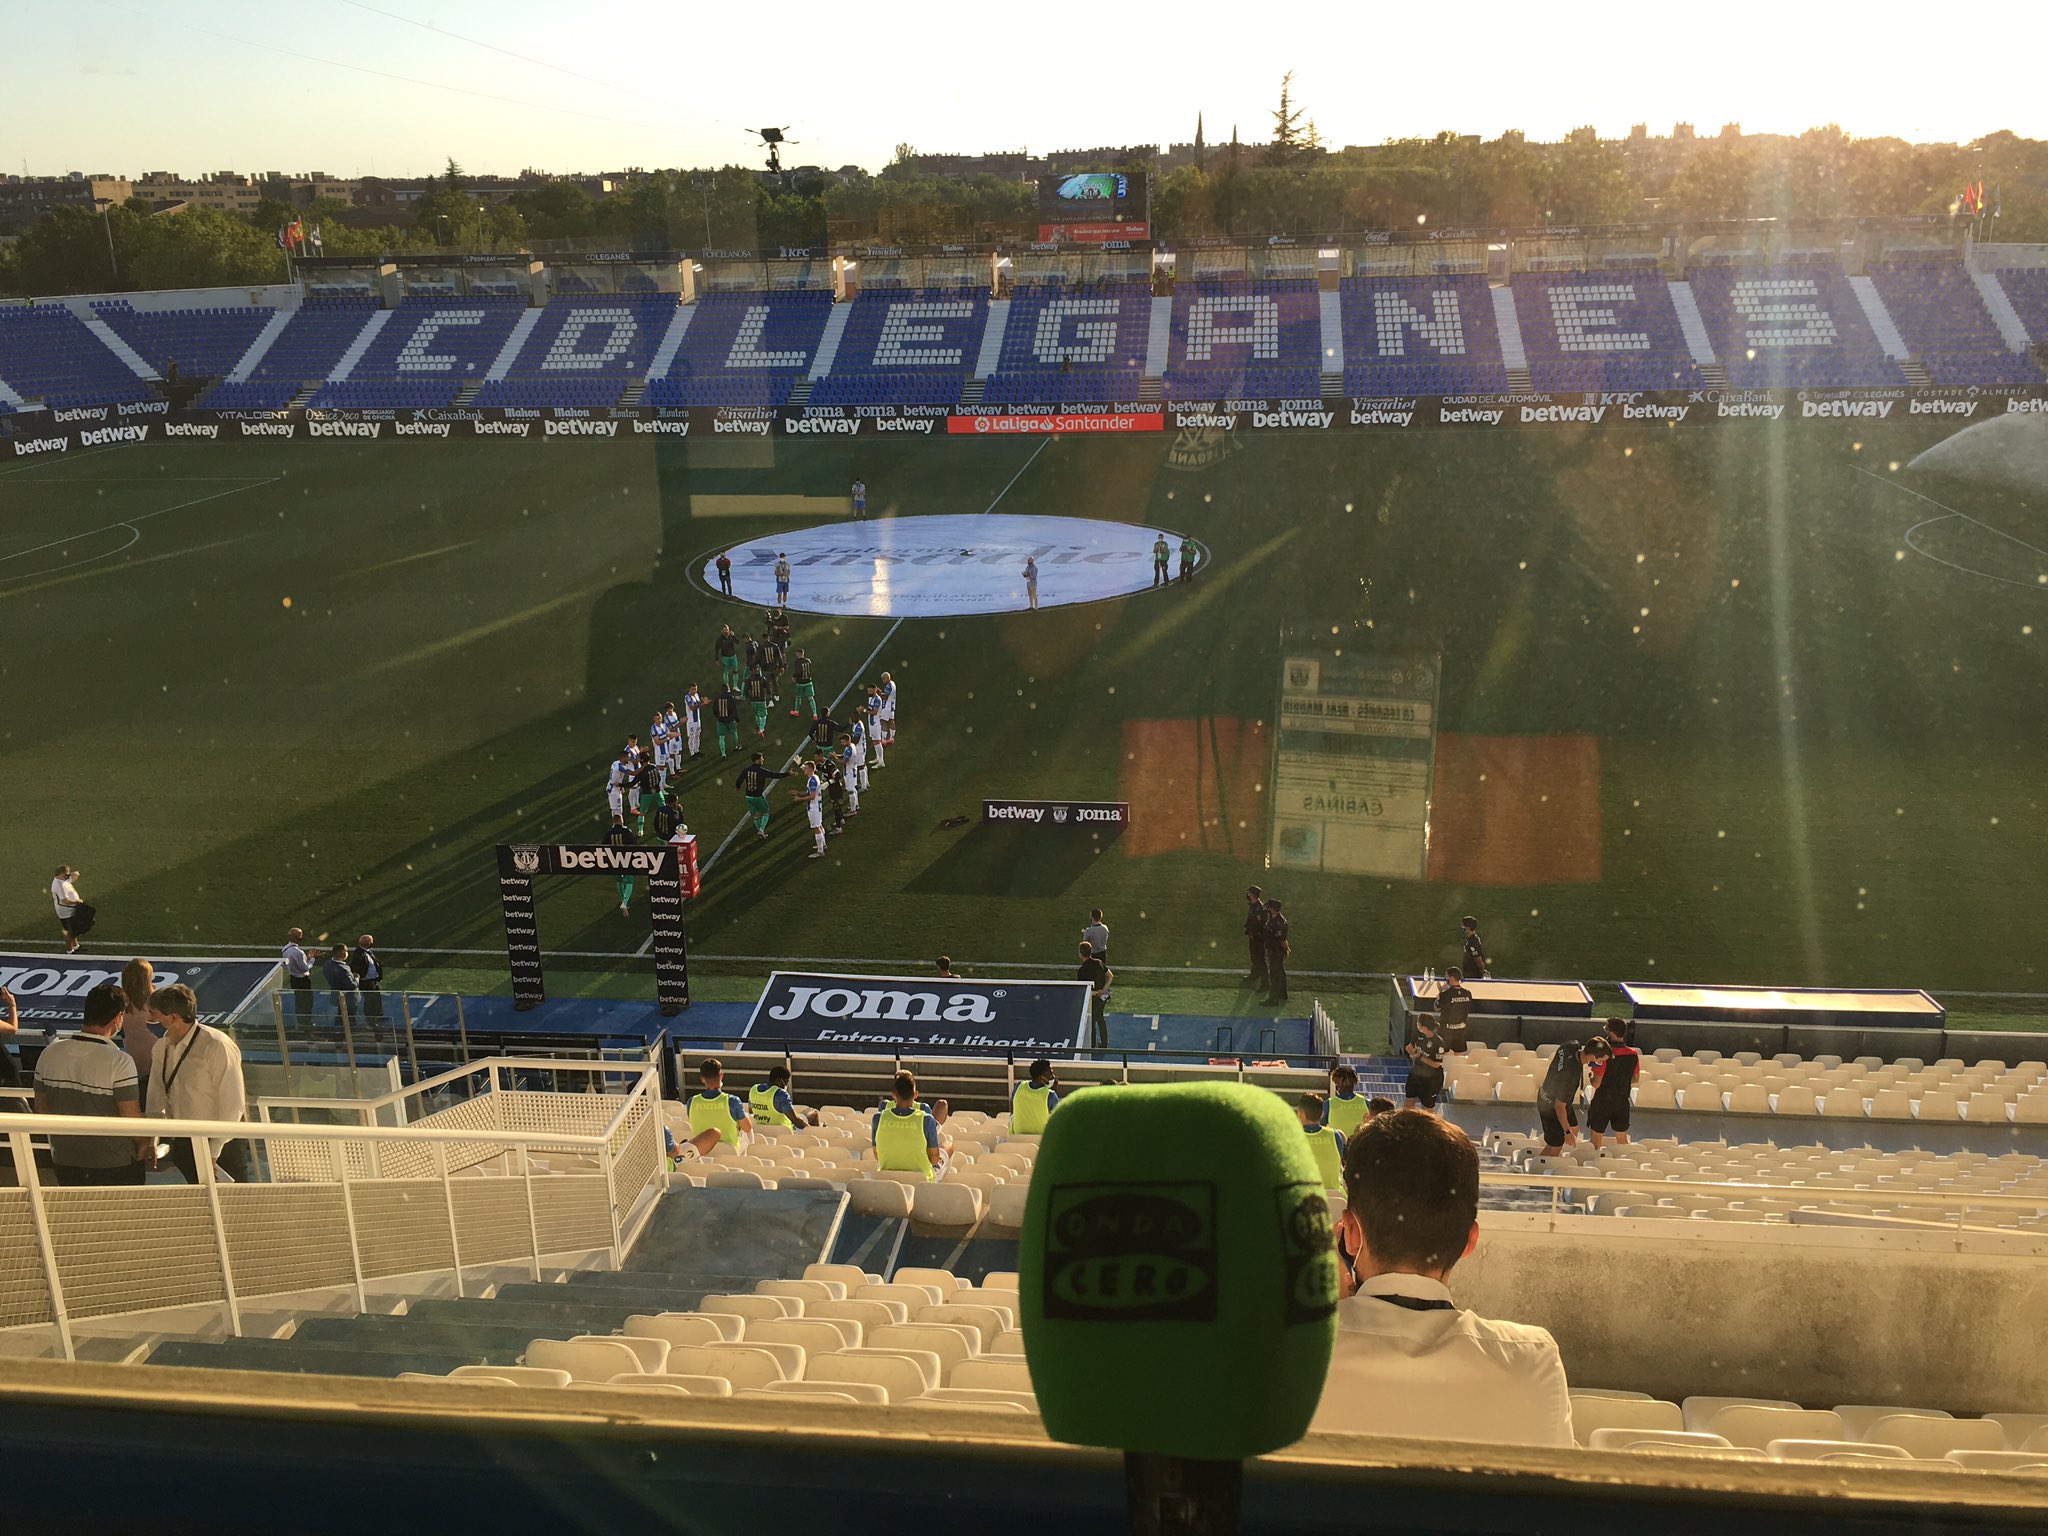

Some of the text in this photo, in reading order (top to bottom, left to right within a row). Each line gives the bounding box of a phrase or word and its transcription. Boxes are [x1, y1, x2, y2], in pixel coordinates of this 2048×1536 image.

[788, 248, 810, 257] KFC
[1031, 243, 1059, 251] betway
[1442, 396, 1477, 404] CIUDAD
[1478, 395, 1496, 403] DEL
[1600, 393, 1643, 404] KFC
[1707, 390, 1773, 402] CaixaBank
[117, 401, 169, 416] betway
[504, 408, 540, 418] Mahou
[554, 407, 590, 417] Mahou
[903, 405, 950, 417] betway
[956, 404, 1002, 416] betway
[1008, 404, 1055, 415] betway
[1061, 403, 1108, 414] betway
[1113, 402, 1161, 414] betway
[1168, 401, 1216, 413] betway
[1623, 404, 1689, 421] betway
[1718, 401, 1784, 419] betway
[1802, 400, 1893, 418] betway
[1910, 399, 1978, 417] betway
[54, 407, 108, 422] betway
[216, 411, 289, 419] VITALDENT
[428, 408, 484, 420] CaixaBank
[1253, 412, 1334, 428] betway
[1350, 410, 1413, 427] betway
[1440, 408, 1503, 425] betway
[1521, 405, 1606, 423] betway
[633, 419, 689, 436] betway
[714, 419, 770, 435] betway
[786, 418, 861, 434] betway
[876, 417, 934, 433] betway
[993, 416, 1134, 432] LaLiga Santander
[1176, 413, 1236, 430] betway
[165, 422, 218, 438] betway
[241, 422, 294, 438] betway
[309, 421, 380, 438] betway
[395, 420, 450, 437] betway
[474, 420, 530, 437] betway
[544, 420, 618, 436] betway
[81, 425, 148, 446] betway
[14, 437, 69, 455] betway
[988, 805, 1045, 822] betway
[558, 846, 666, 875] betway
[501, 878, 529, 886] betway
[650, 879, 678, 887] betway
[503, 894, 531, 902] betway
[651, 896, 679, 904] betway
[505, 910, 533, 918] betway
[653, 913, 680, 921] betway
[507, 927, 535, 935] betway
[654, 930, 682, 938] betway
[509, 943, 537, 951] betway
[655, 946, 683, 954] betway
[512, 960, 539, 968] betway
[657, 963, 685, 971] betway
[513, 976, 541, 984] betway
[658, 979, 686, 987] betway
[515, 992, 543, 1000] betway
[660, 996, 687, 1004] betway
[1067, 1212, 1185, 1237] ONDA
[1070, 1263, 1189, 1298] CERO
